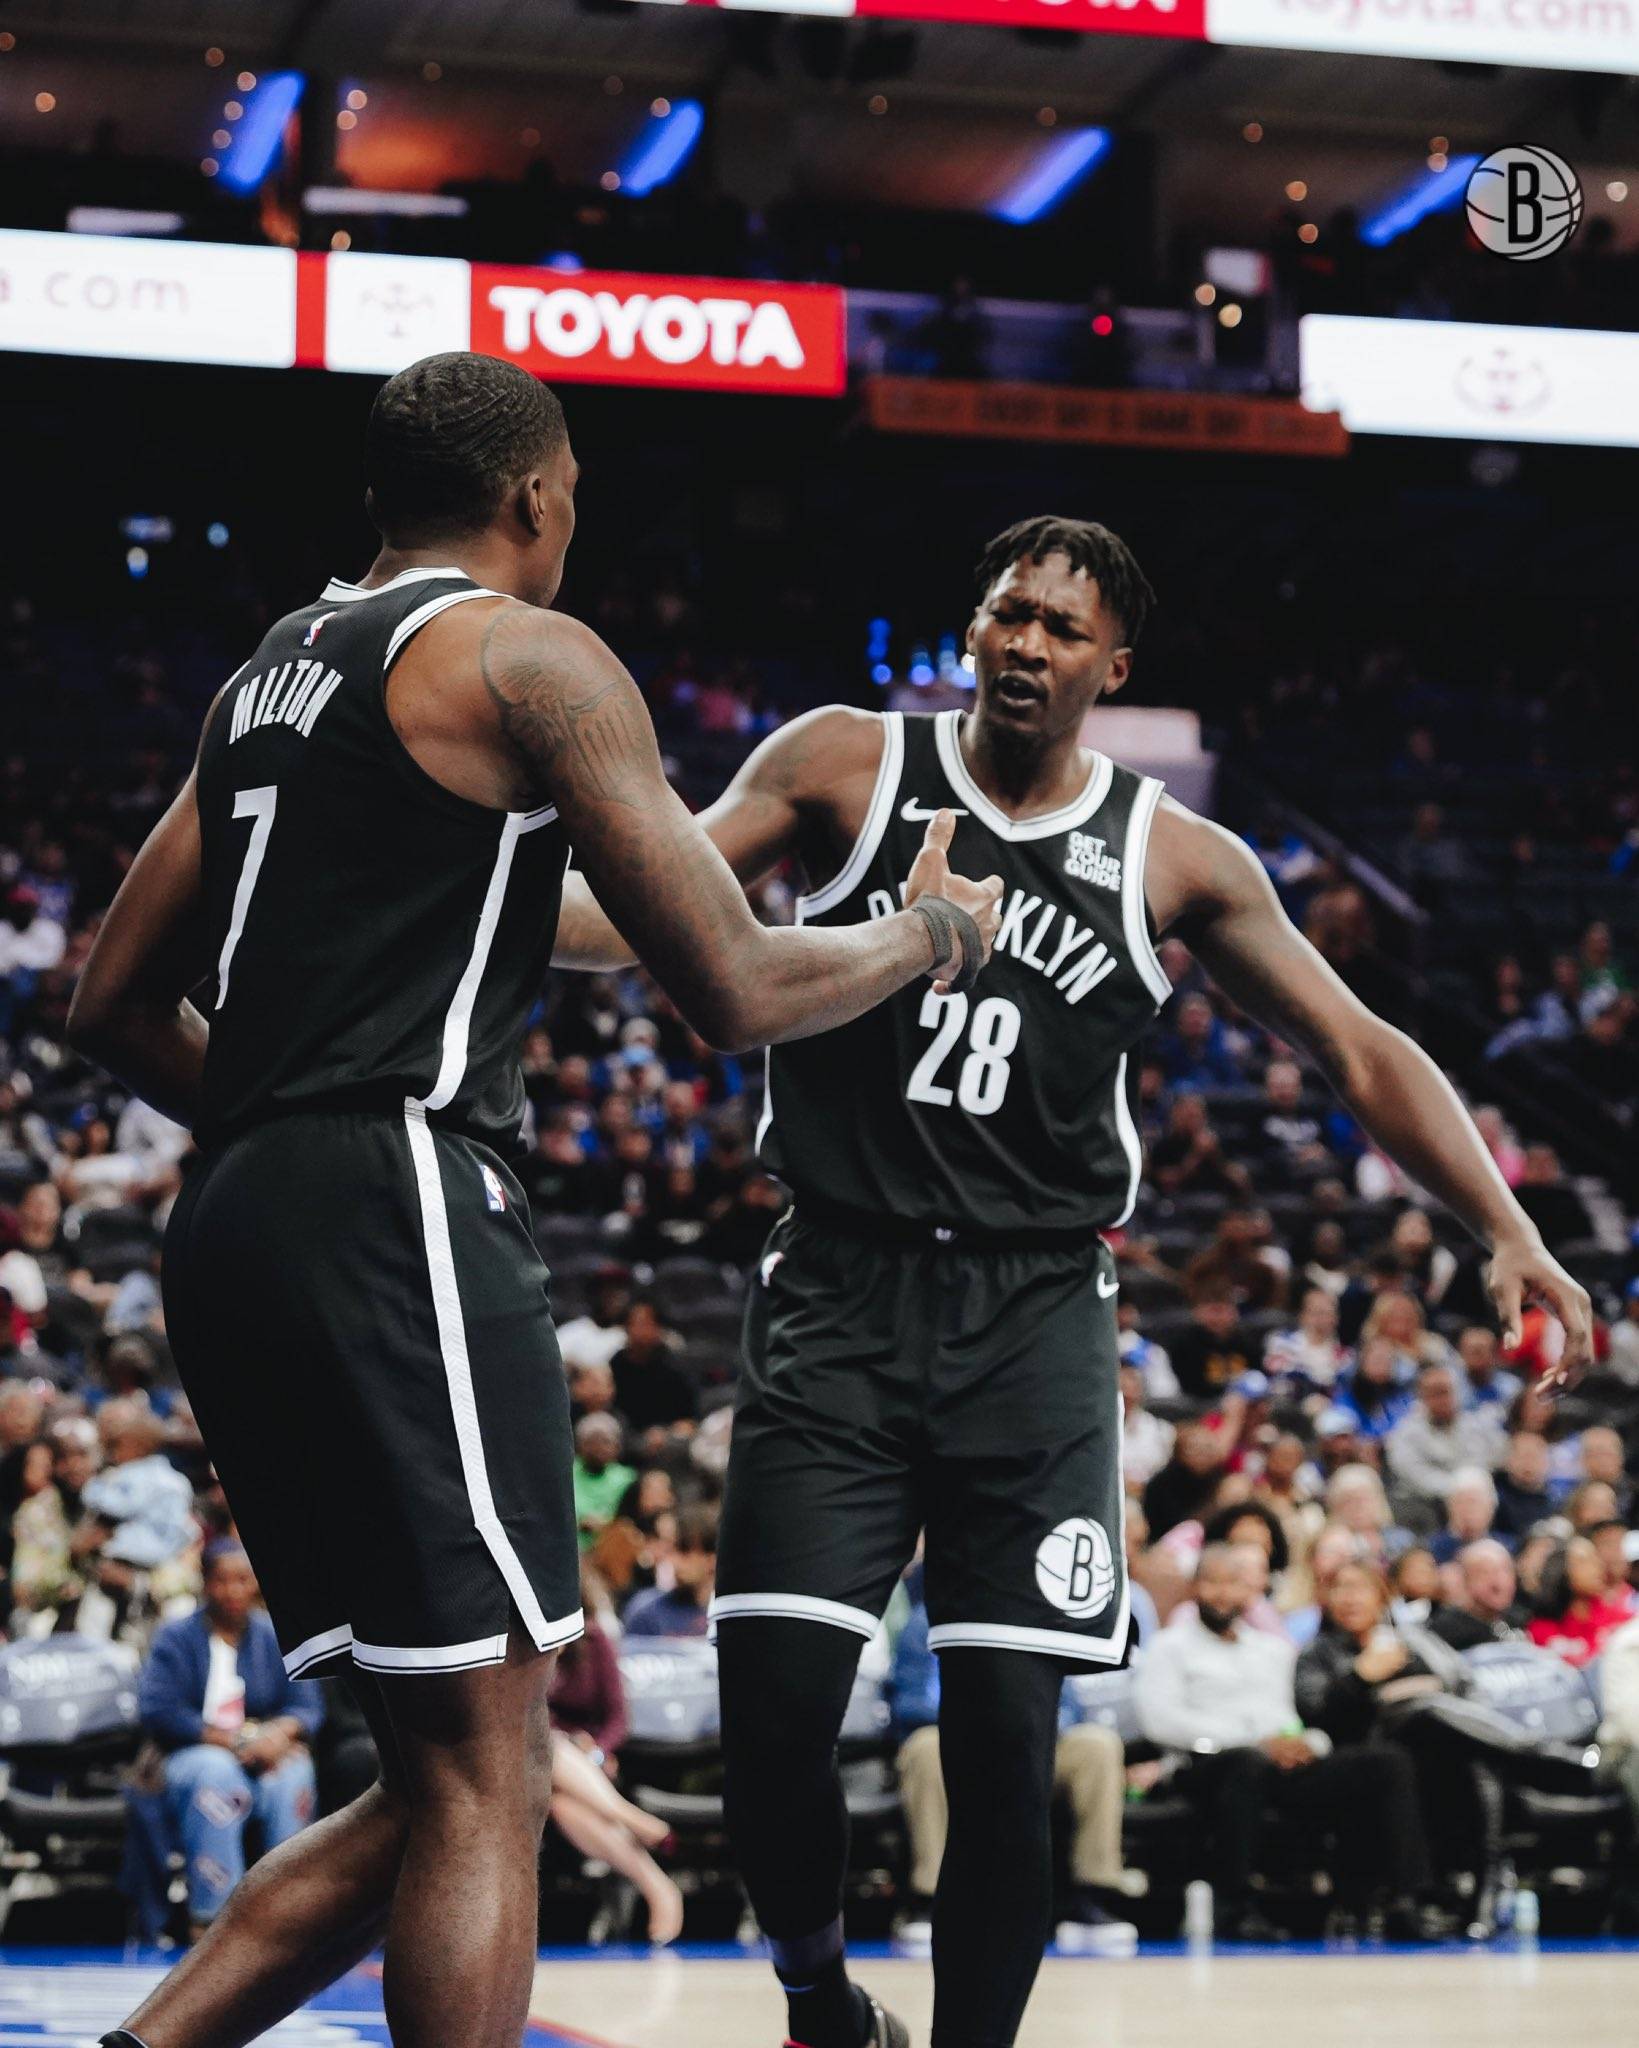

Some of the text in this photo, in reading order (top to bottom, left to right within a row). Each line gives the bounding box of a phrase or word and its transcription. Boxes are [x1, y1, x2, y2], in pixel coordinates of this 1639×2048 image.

[489, 285, 805, 369] TOYOTA
[229, 659, 343, 744] MILTON
[1064, 858, 1121, 892] GUIDE
[1068, 831, 1107, 853] GET
[1068, 845, 1121, 875] YOUR
[214, 785, 278, 1010] 7
[867, 880, 1118, 1005] KLYN
[906, 988, 1021, 1116] 28
[1068, 1532, 1093, 1601] B
